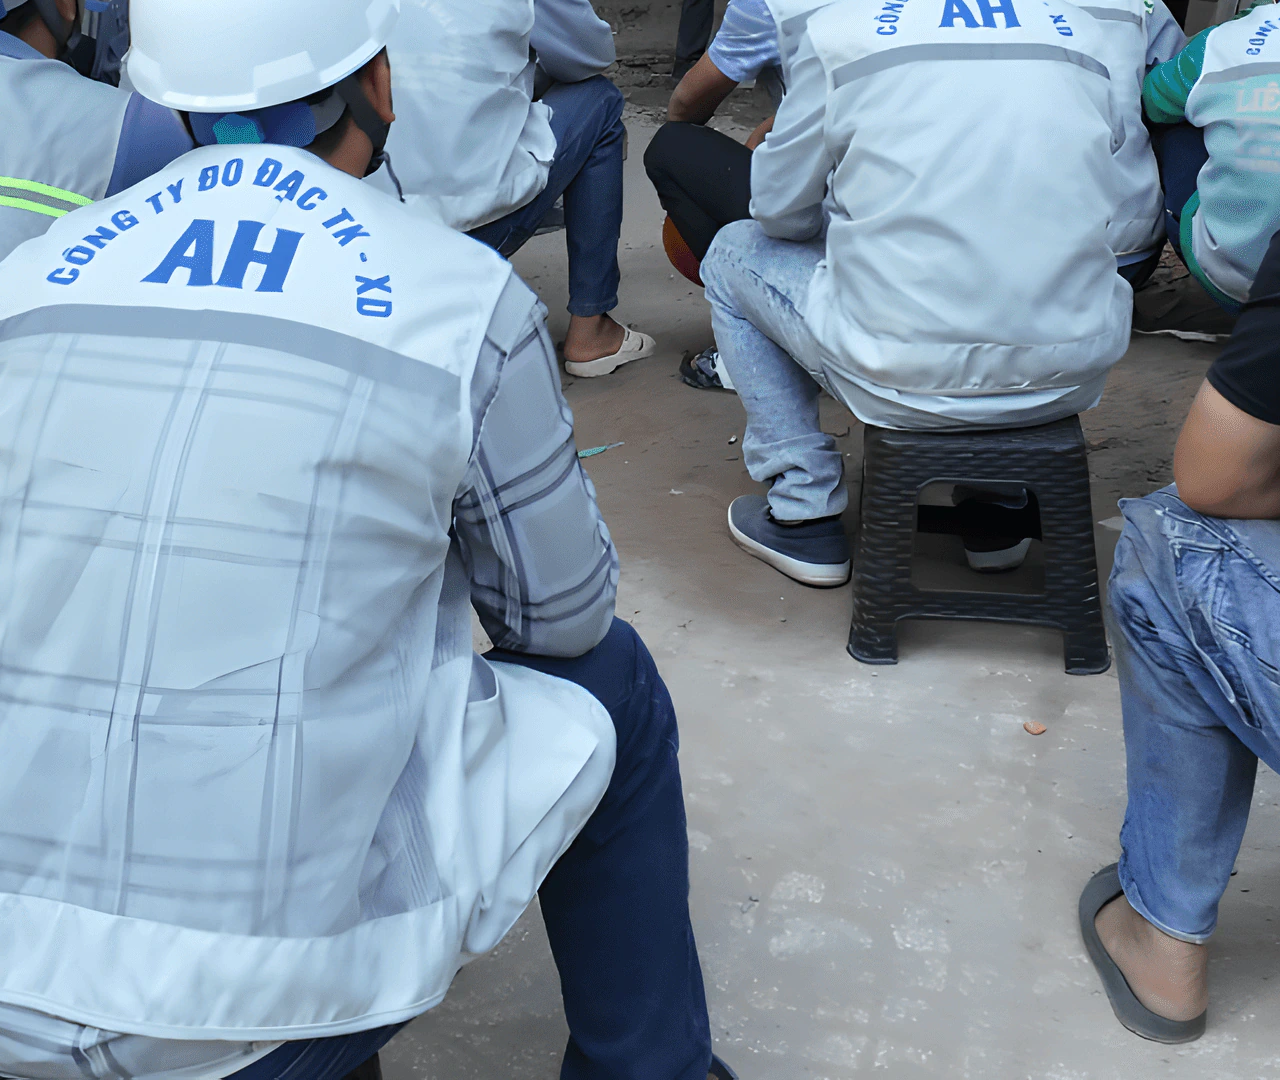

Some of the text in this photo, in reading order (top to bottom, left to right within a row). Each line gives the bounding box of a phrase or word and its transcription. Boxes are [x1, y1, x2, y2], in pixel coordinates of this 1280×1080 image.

[46, 210, 139, 285] CÔNG
[145, 179, 183, 214] TY
[198, 158, 243, 191] ĐO
[253, 155, 327, 210] ĐẠC
[322, 208, 370, 246] TK
[355, 275, 392, 317] XD
[141, 219, 304, 292] AH
